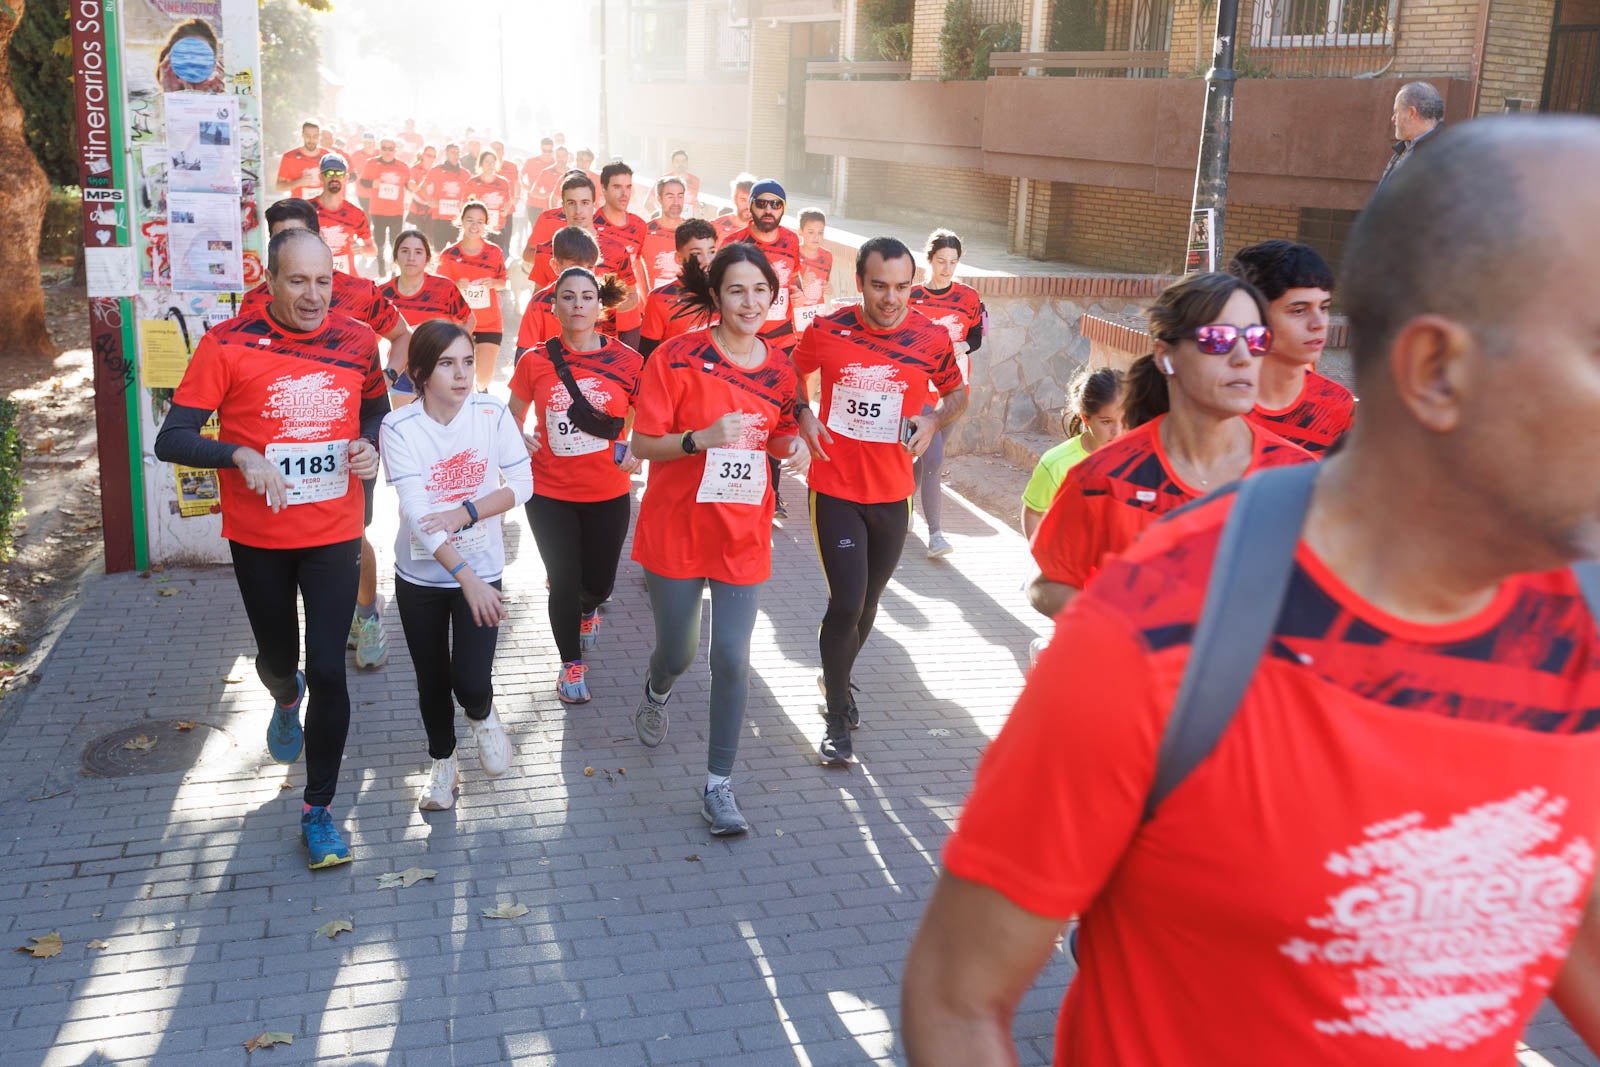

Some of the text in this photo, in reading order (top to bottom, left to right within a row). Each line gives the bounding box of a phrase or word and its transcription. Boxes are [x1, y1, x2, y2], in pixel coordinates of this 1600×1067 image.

[78, 41, 107, 165] tinerarios
[86, 190, 122, 200] MPS
[464, 289, 484, 298] 1027
[841, 376, 902, 394] carrera
[270, 391, 344, 406] carrera
[271, 406, 344, 420] cruzroja.es
[846, 398, 881, 418] 355
[853, 418, 875, 426] ANTONIO
[280, 454, 336, 476] 1183
[432, 463, 486, 482] carrera
[719, 461, 751, 480] 332
[1334, 866, 1577, 929] carrera
